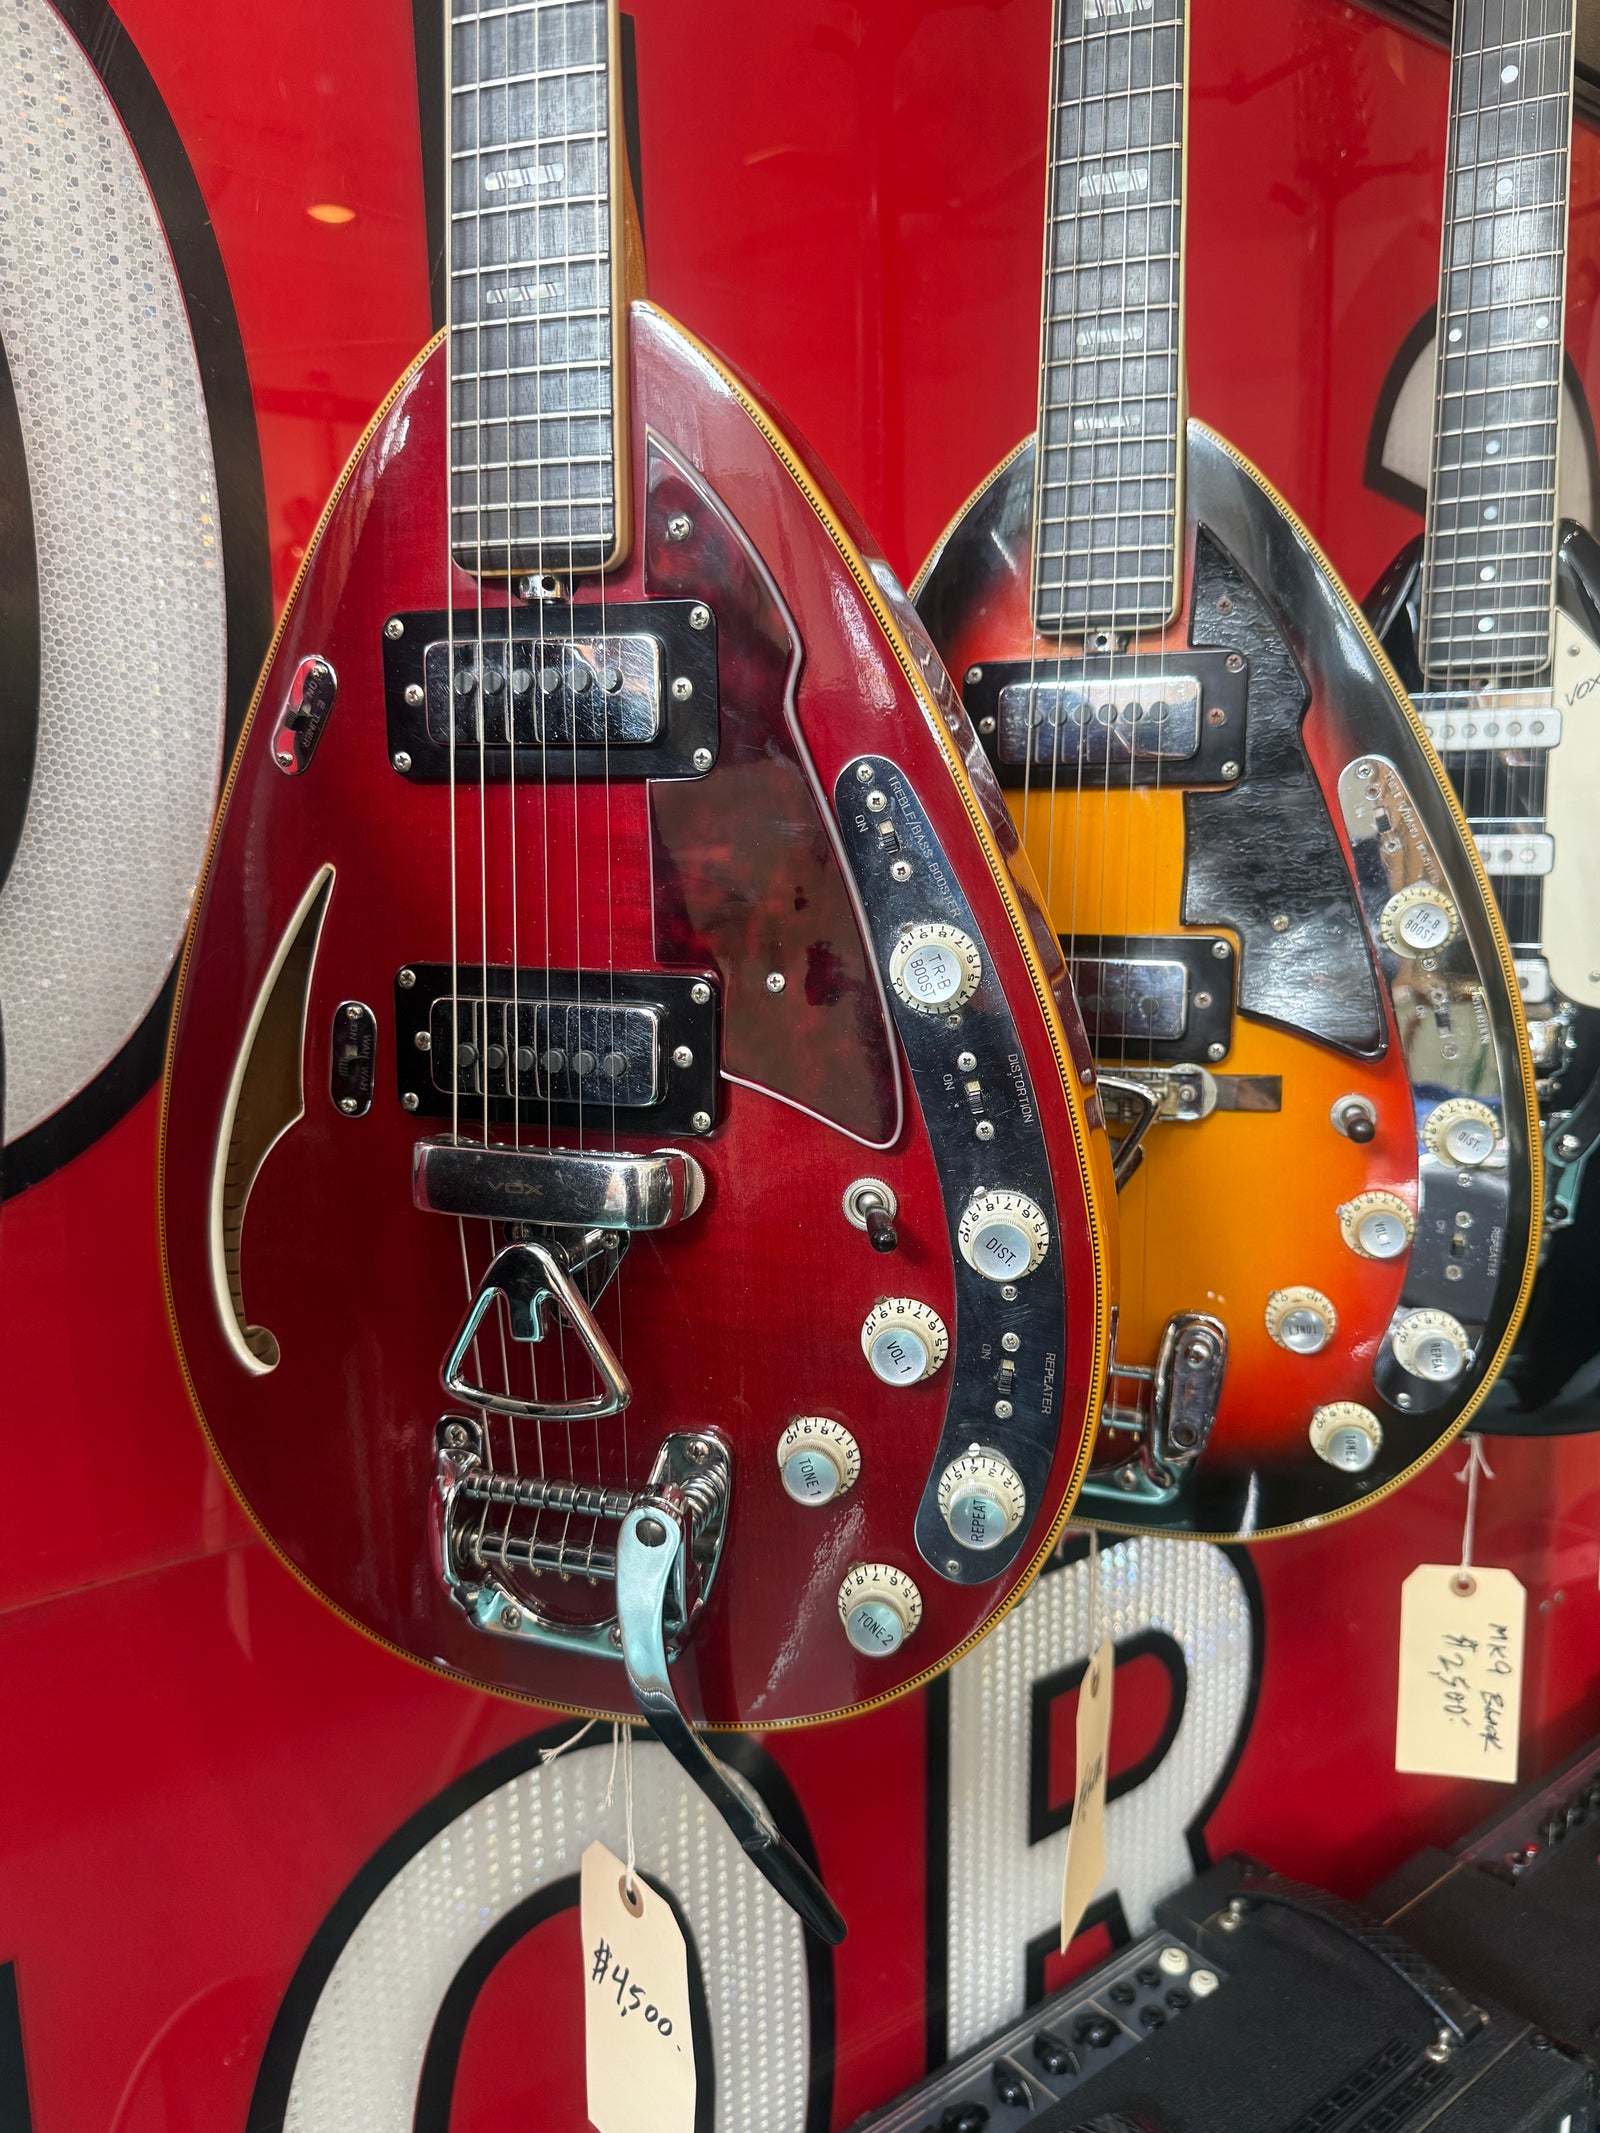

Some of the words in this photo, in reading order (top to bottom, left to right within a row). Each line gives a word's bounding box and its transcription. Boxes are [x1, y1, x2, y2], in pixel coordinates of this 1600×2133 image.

[302, 714, 320, 748] TUNER
[855, 814, 869, 833] ON
[888, 775, 933, 858] TREBLE/BASS
[928, 862, 961, 917] BOOSTER
[1404, 919, 1436, 942] BOOST
[910, 958, 936, 997] BOOST
[360, 1035, 372, 1059] WAH
[360, 1066, 370, 1091] WAH
[943, 1073, 955, 1091] ON
[1008, 1053, 1034, 1124] DISTORTION
[1458, 1132, 1481, 1151] DIST.
[486, 1181, 544, 1196] VOX
[985, 1237, 1017, 1267] DIST.
[1487, 1226, 1501, 1277] REPEATER
[886, 1340, 906, 1365] VOL
[900, 1366, 912, 1374] 1
[981, 1343, 991, 1360] ON
[1041, 1352, 1056, 1415] REPEATER
[798, 1457, 820, 1489] TONE
[971, 1499, 987, 1542] REPEAT
[857, 1611, 887, 1639] TONE
[881, 1634, 894, 1646] 2
